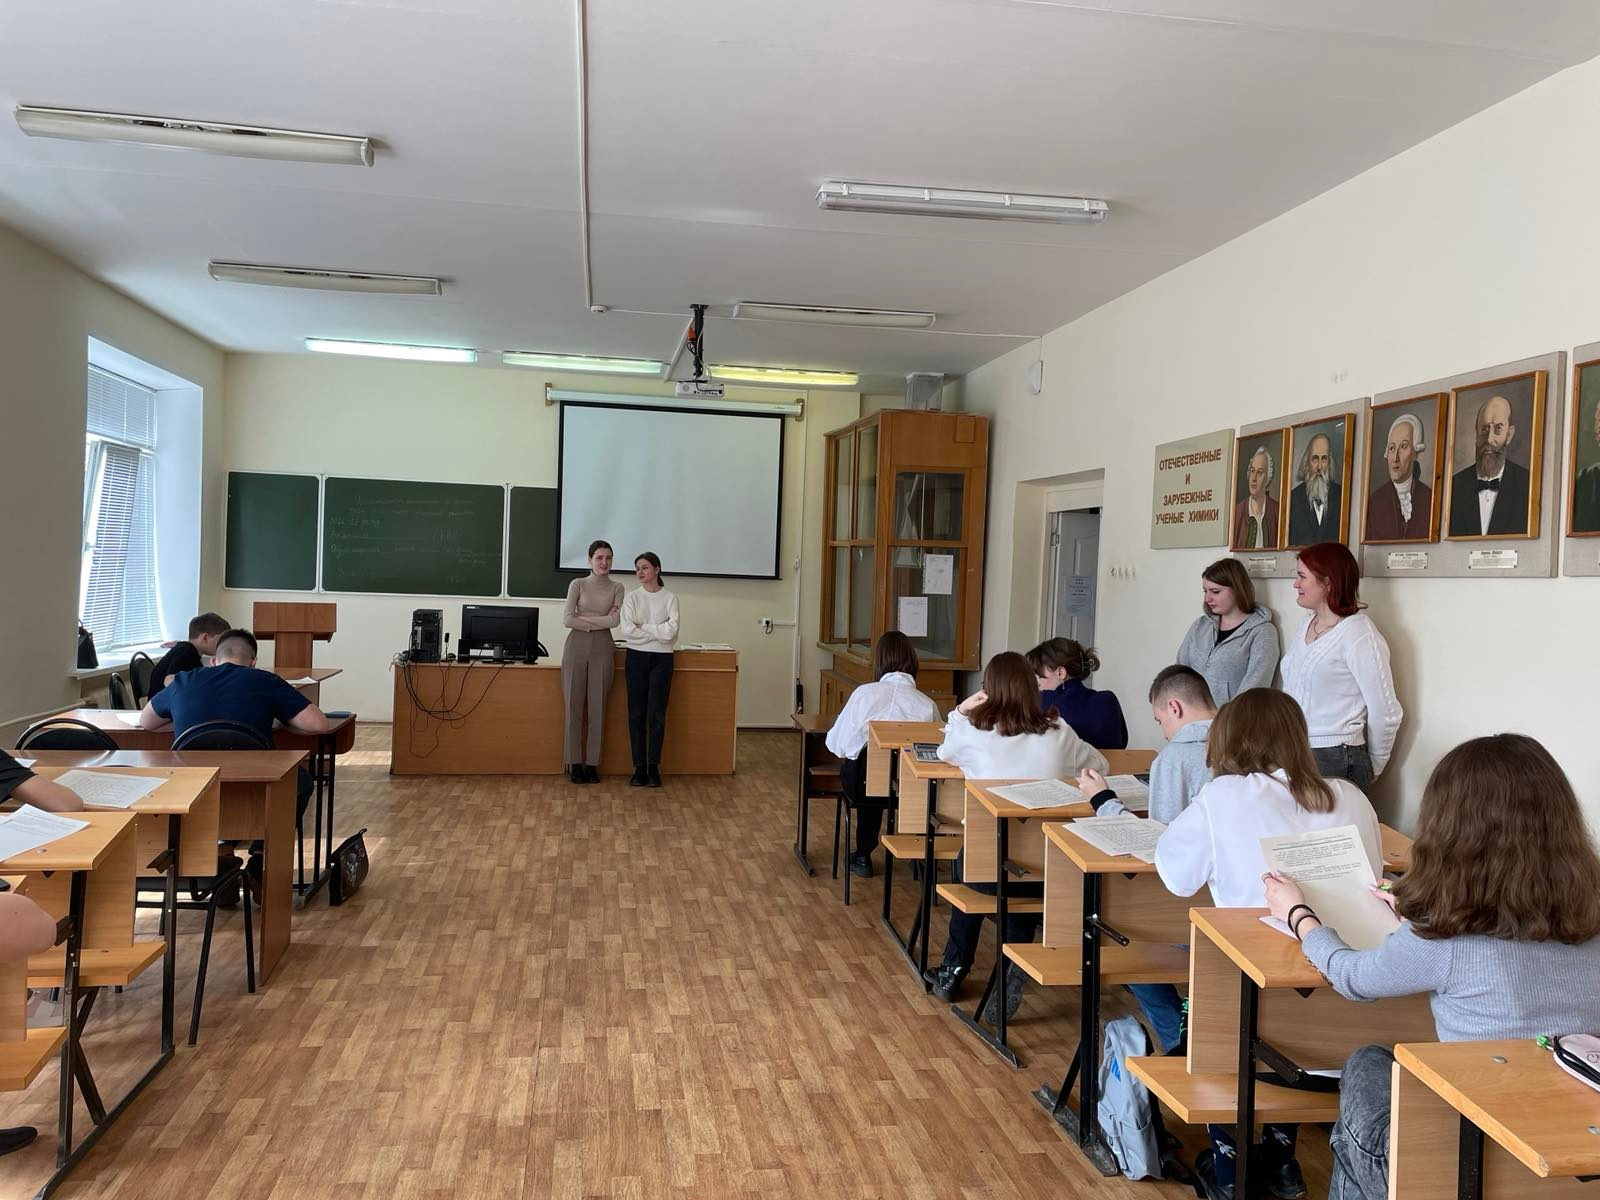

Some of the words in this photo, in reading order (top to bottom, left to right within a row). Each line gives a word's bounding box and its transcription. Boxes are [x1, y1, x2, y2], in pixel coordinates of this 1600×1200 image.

[1159, 448, 1221, 471] ОТЕЧЕСТВЕННЫЕ
[1185, 473, 1191, 485] И
[1163, 489, 1212, 506] ЗАРУБЕЖНЫЕ
[1155, 511, 1184, 525] УЧЕНЫЕ
[1188, 508, 1219, 523] ХИМИКИ
